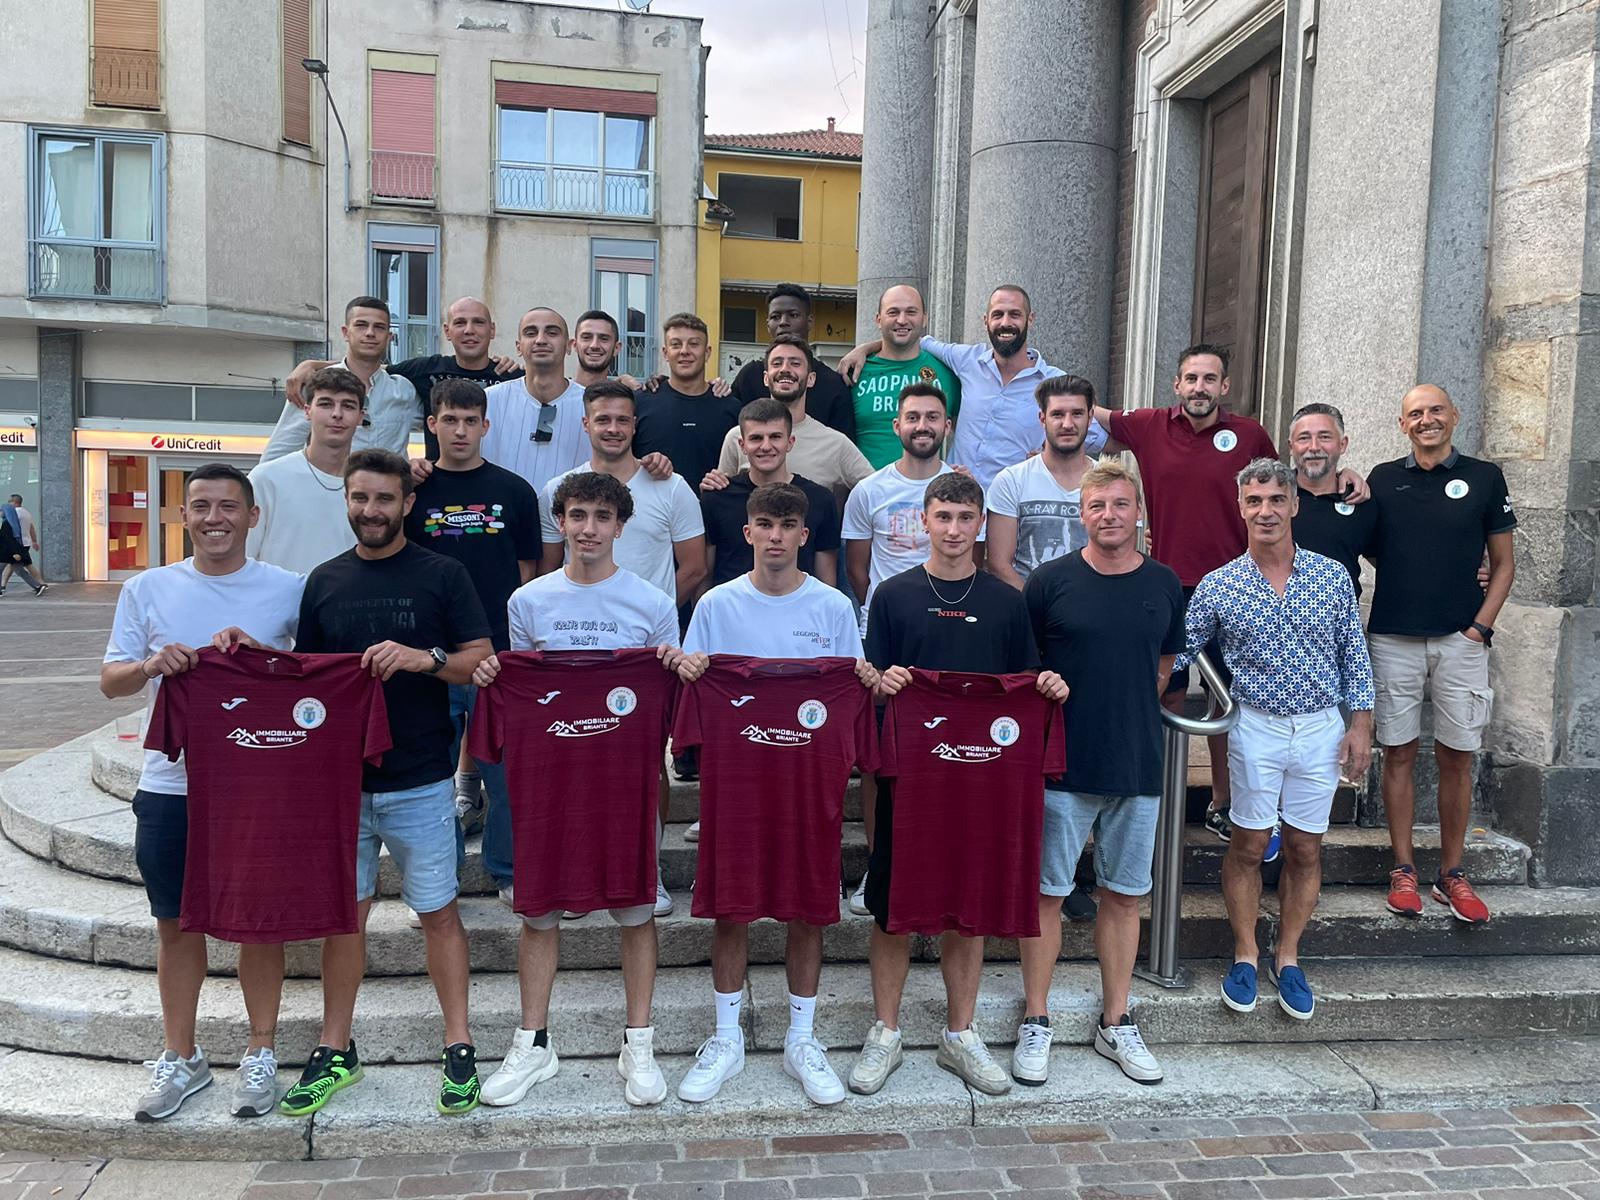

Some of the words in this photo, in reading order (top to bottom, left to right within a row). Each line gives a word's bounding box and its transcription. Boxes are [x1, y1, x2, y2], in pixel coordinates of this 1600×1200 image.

[1, 432, 25, 444] edit
[166, 438, 222, 450] UniCredit
[1023, 503, 1057, 515] X-RAY
[1060, 504, 1080, 516] RO
[447, 514, 480, 522] MISSONI
[398, 597, 414, 607] OF
[811, 636, 831, 644] NEVER
[573, 717, 620, 726] IMMOBILIARE
[767, 727, 812, 739] IMMOBILIARE
[956, 744, 1002, 753] IMMOBILIARE
